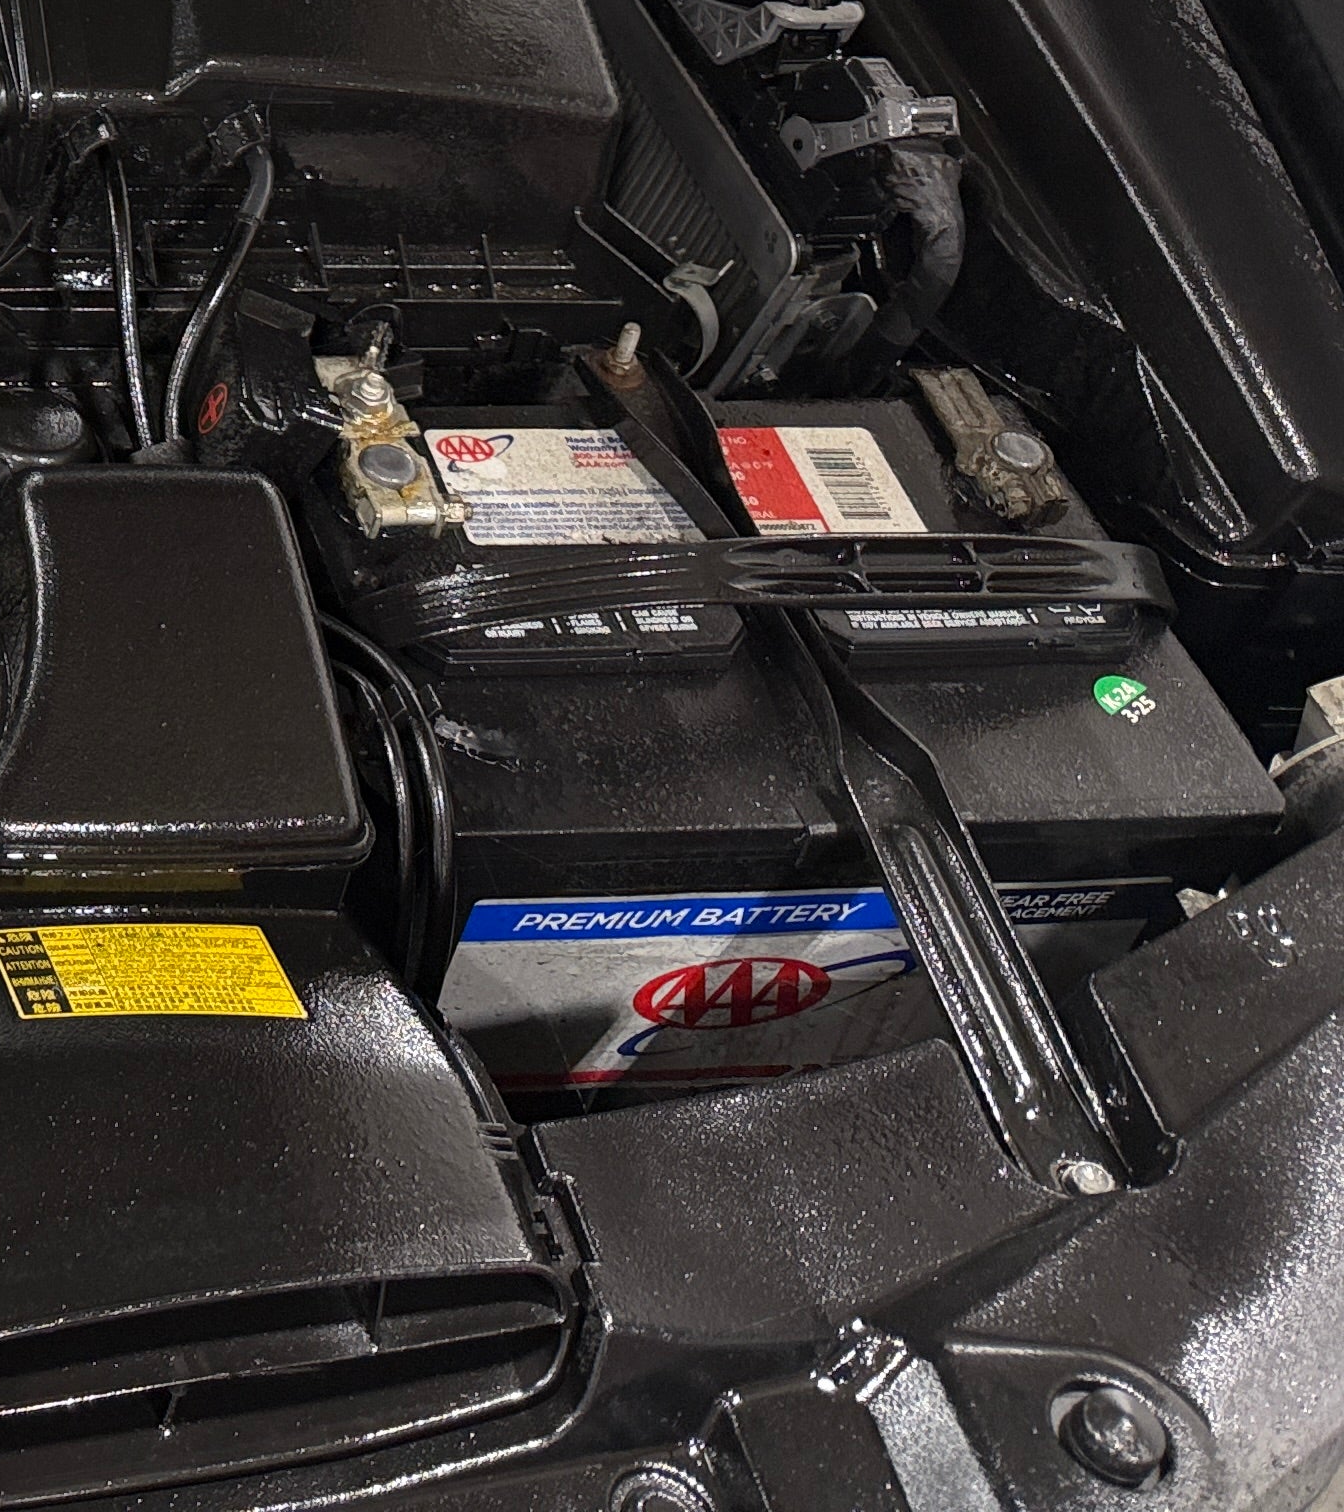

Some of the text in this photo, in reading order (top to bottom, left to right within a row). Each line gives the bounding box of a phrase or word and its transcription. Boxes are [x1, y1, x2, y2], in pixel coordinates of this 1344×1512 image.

[441, 435, 491, 462] AAA
[1051, 890, 1116, 906] FREE
[512, 902, 867, 932] PREMIUM BATTERY
[1009, 904, 1104, 919] ACEMENT
[5, 960, 52, 972] ATTENTION
[647, 960, 812, 1029] AAA
